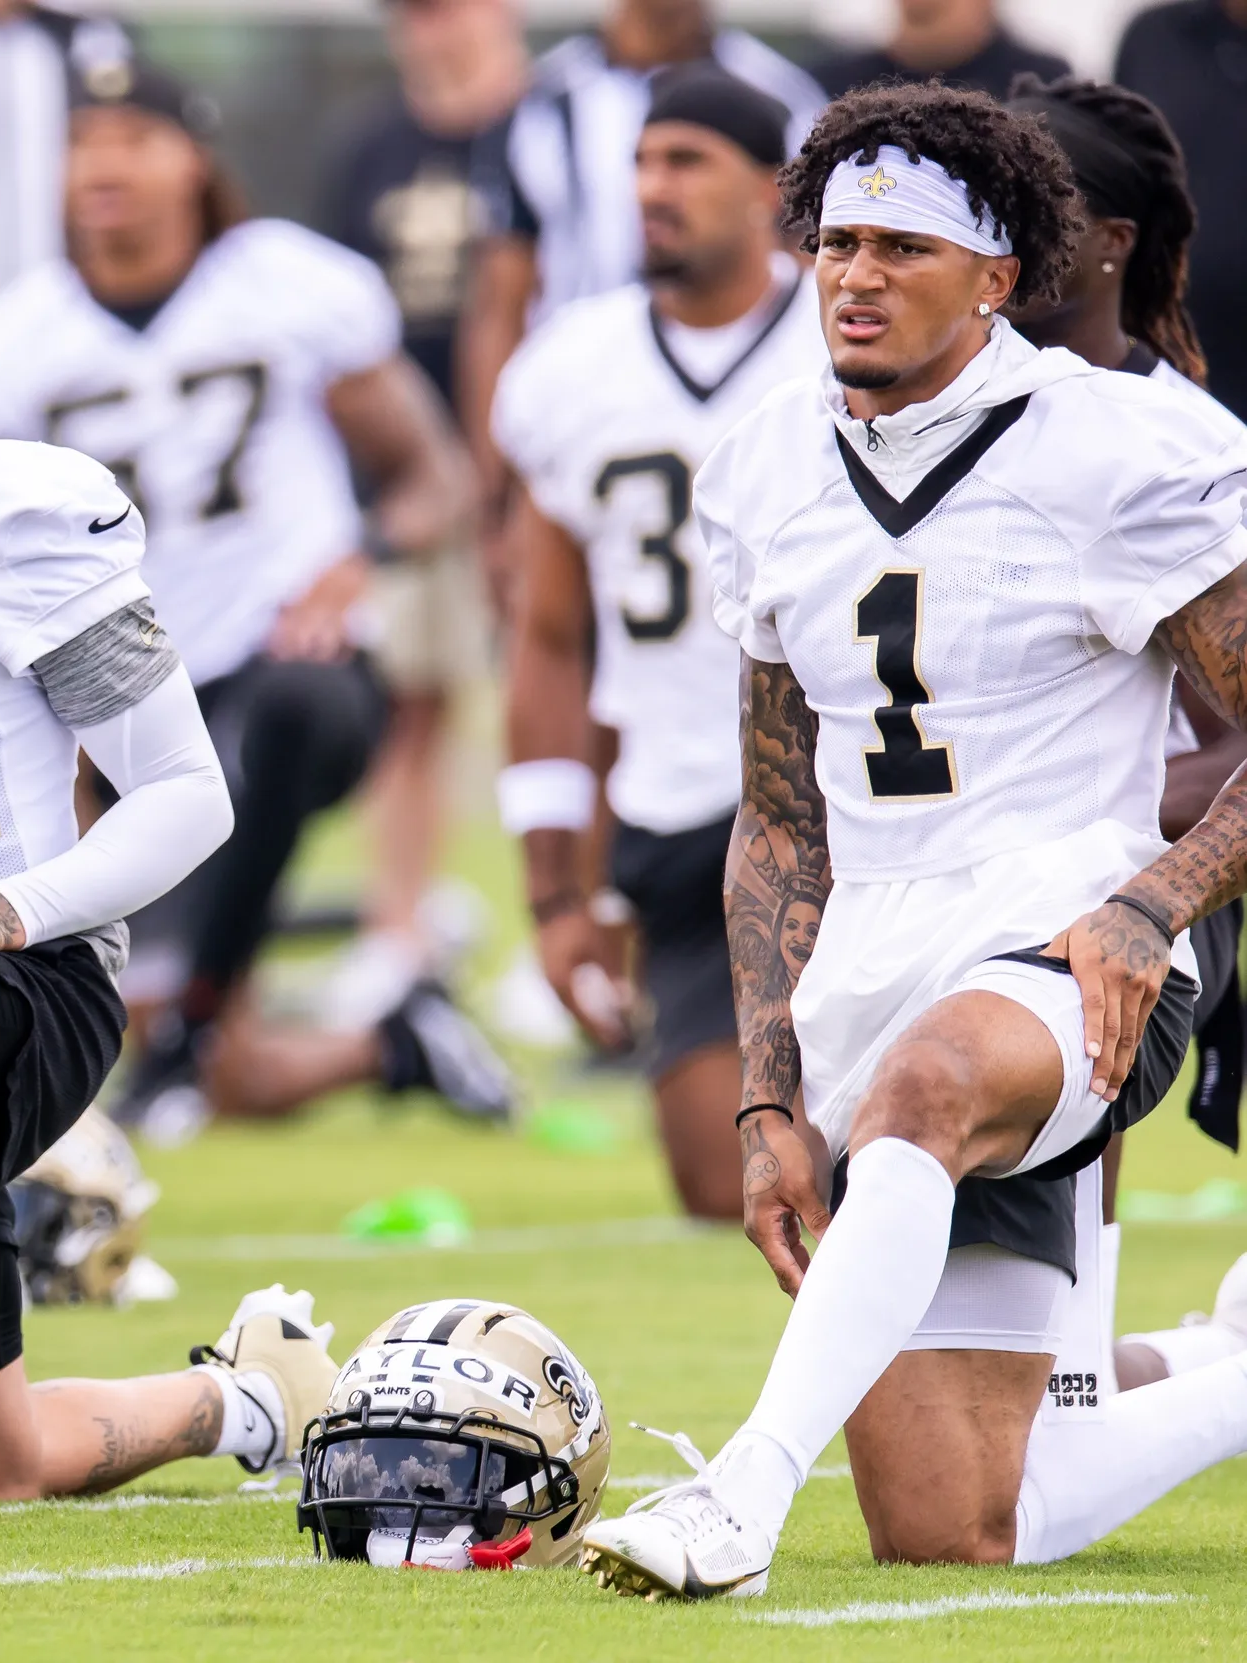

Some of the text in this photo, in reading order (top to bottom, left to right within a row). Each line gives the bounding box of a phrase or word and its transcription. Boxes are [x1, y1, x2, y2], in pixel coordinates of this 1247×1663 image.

[853, 567, 960, 804] 1
[335, 1348, 536, 1411] AYLOR
[373, 1386, 411, 1396] SAINTS
